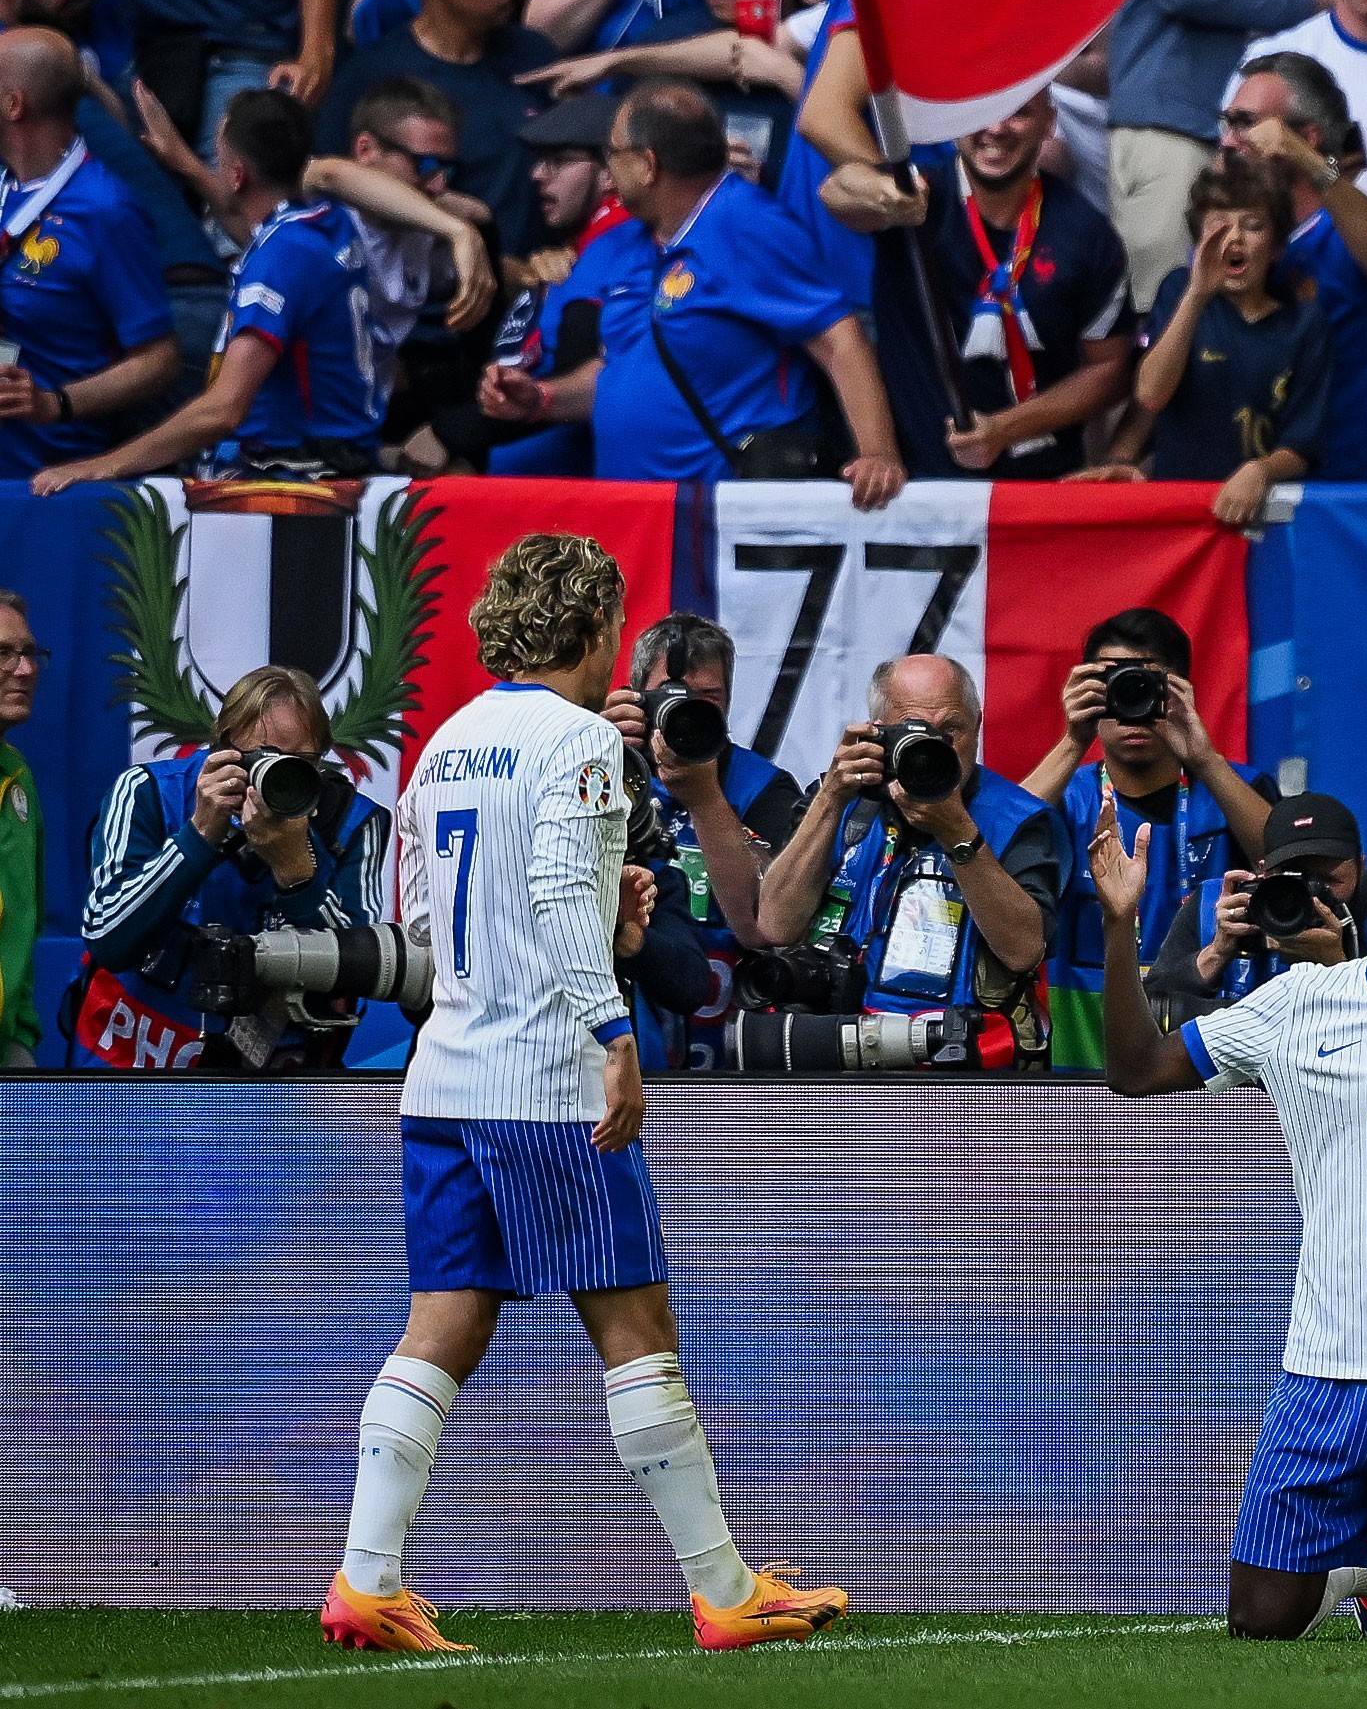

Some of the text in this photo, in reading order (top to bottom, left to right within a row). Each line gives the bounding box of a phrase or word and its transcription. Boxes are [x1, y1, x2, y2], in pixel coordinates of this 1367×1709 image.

[734, 544, 982, 760] 77
[419, 746, 521, 787] GRIEZMANN
[435, 808, 479, 980] 7
